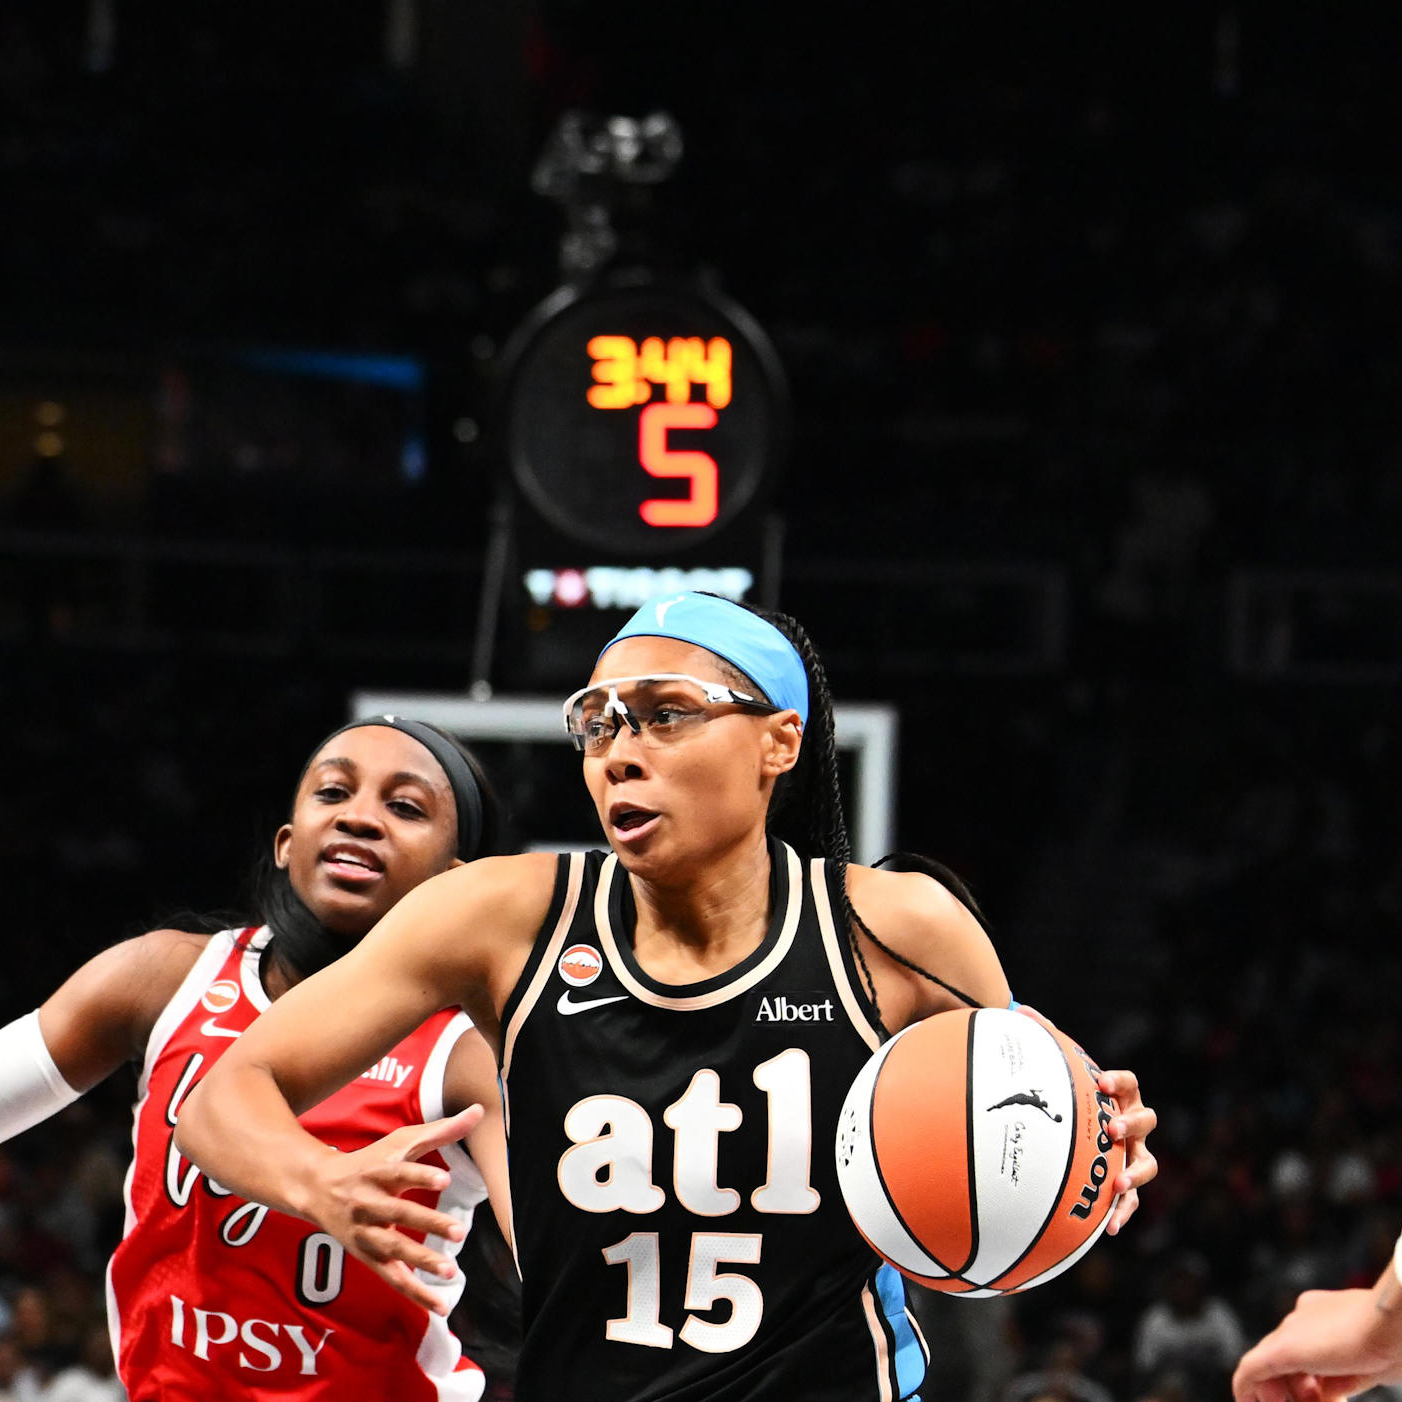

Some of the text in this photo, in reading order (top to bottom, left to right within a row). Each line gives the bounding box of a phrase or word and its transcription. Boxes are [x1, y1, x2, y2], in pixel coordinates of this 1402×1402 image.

[639, 402, 718, 527] 5
[755, 996, 834, 1022] Albert
[301, 1231, 346, 1305] 0
[601, 1232, 764, 1353] 15
[169, 1294, 336, 1376] IPSY
